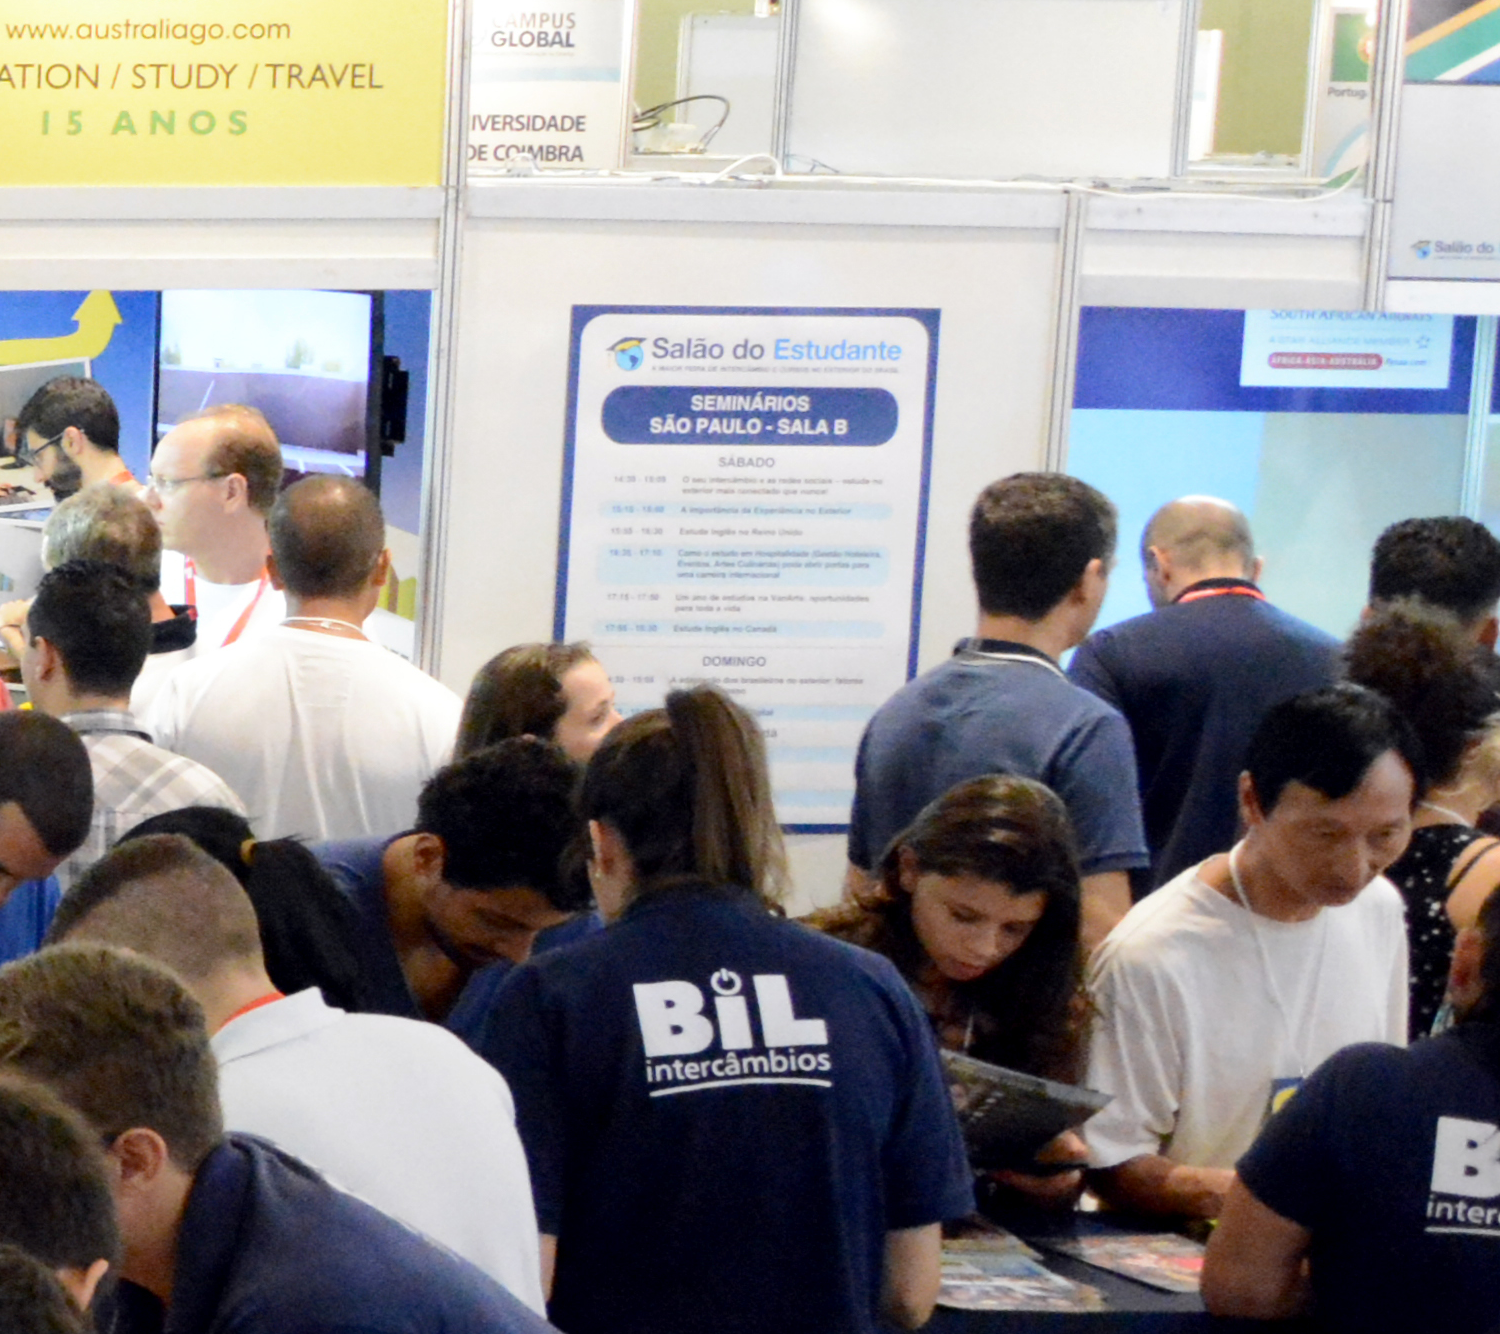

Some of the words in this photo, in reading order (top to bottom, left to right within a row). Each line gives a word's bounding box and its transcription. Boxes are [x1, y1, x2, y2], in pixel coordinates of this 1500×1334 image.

[4, 17, 291, 45] www.australiago.com
[492, 12, 576, 29] CAMPUS
[491, 31, 575, 48] GLOBAL
[132, 64, 238, 90] STUDY
[268, 64, 384, 90] TRAVEL
[1327, 87, 1367, 99] Portug
[41, 110, 85, 137] 15
[111, 109, 251, 137] ANOS
[472, 115, 586, 132] IVERSIDADE
[1435, 240, 1473, 253] Salão
[1476, 242, 1494, 253] do
[652, 337, 724, 360] Salão
[732, 339, 765, 360] do
[774, 339, 902, 361] Estudante
[691, 391, 810, 413] SEMINÁRIOS
[650, 414, 691, 434] SÃO
[696, 419, 762, 434] PAULO
[778, 419, 828, 435] SALA
[834, 419, 848, 435] B
[718, 456, 775, 468] SÁBADO
[702, 657, 766, 667] DOMINGO
[646, 1048, 831, 1083] intercâmbios
[1430, 1116, 1500, 1200] B
